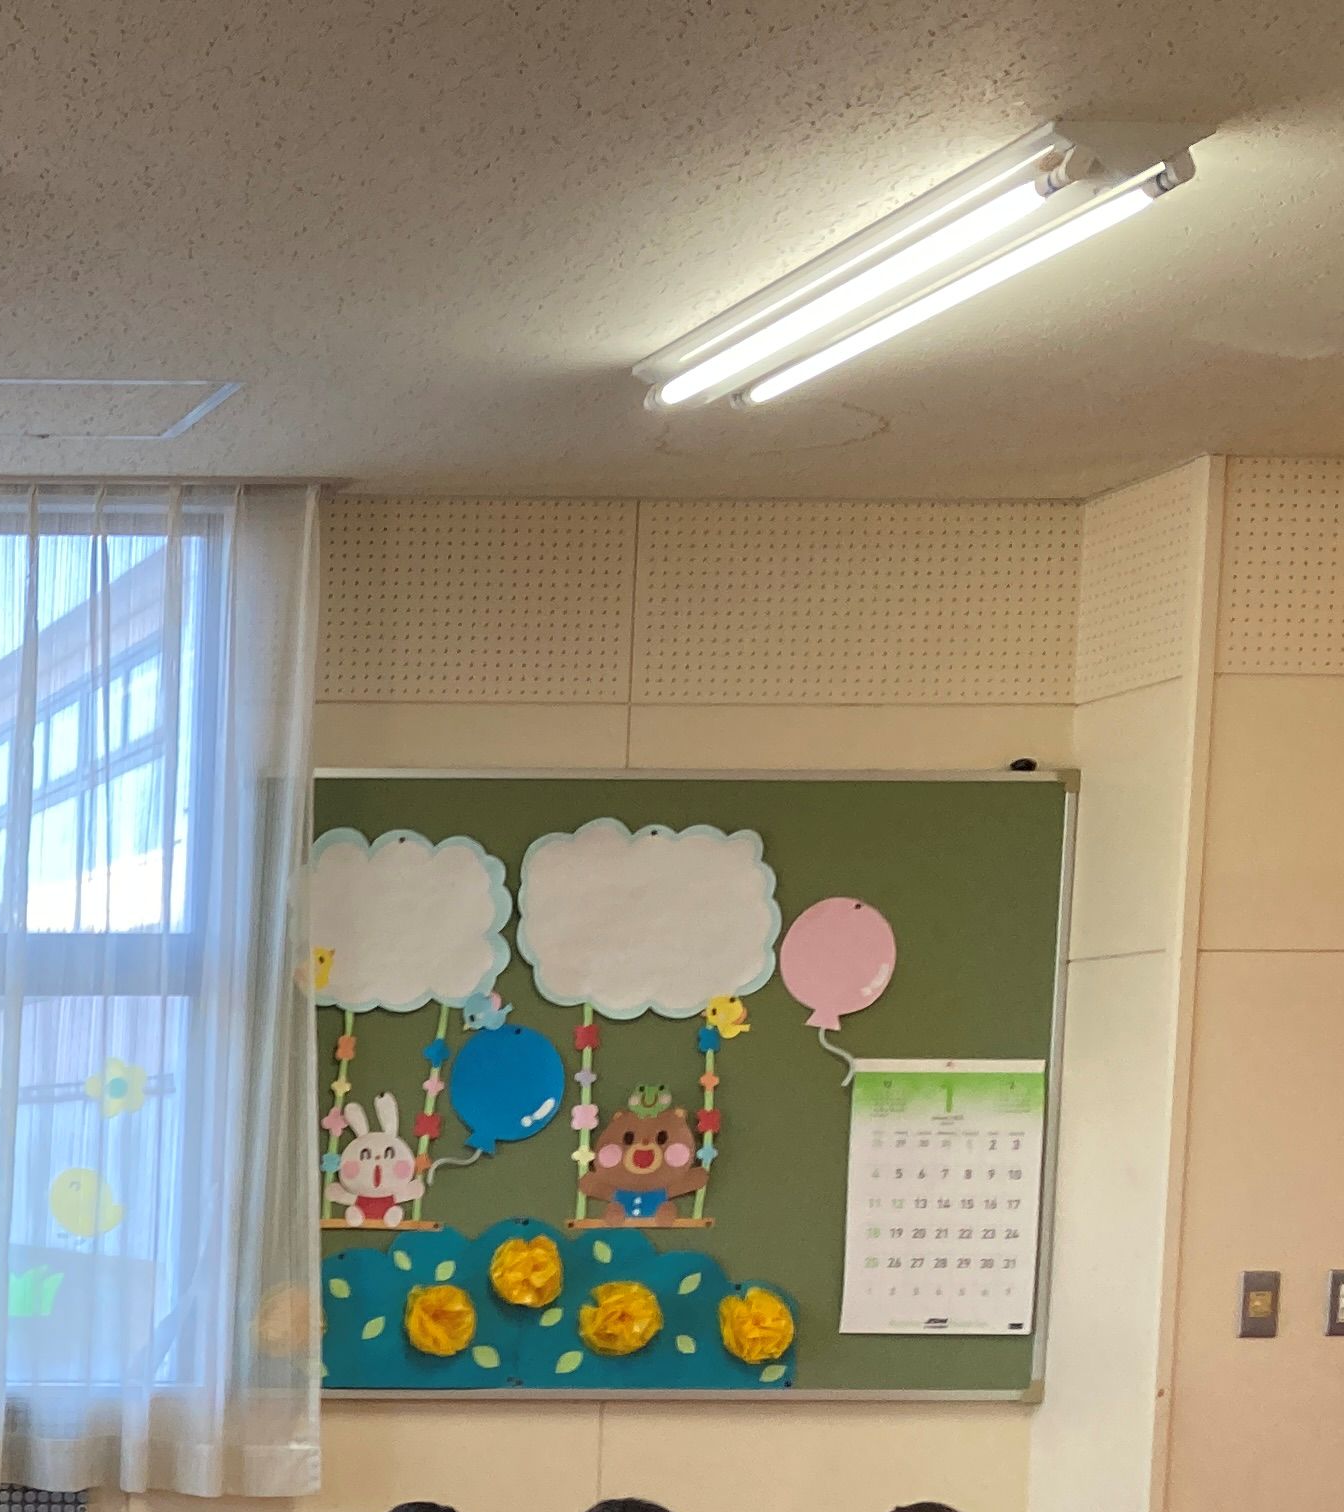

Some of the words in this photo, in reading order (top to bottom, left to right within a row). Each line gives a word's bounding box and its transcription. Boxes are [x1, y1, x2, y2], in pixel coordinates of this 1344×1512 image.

[939, 1080, 953, 1113] 1
[895, 1168, 903, 1179] 5
[917, 1168, 926, 1179] 6
[940, 1169, 949, 1180] 7
[987, 1169, 995, 1180] 9
[914, 1198, 927, 1208] 13
[937, 1199, 950, 1209] 14
[960, 1199, 974, 1209] 15
[984, 1199, 997, 1209] 16
[1007, 1200, 1021, 1210] 17
[890, 1228, 903, 1238] 19
[912, 1228, 926, 1238] 20
[935, 1229, 948, 1239] 21
[958, 1229, 972, 1239] 22
[982, 1229, 995, 1239] 23
[1004, 1230, 1019, 1240] 24
[887, 1257, 901, 1268] 26
[910, 1257, 924, 1268] 27
[933, 1258, 947, 1269] 28
[956, 1258, 971, 1269] 29
[979, 1258, 994, 1269] 30
[1001, 1259, 1016, 1270] 31
